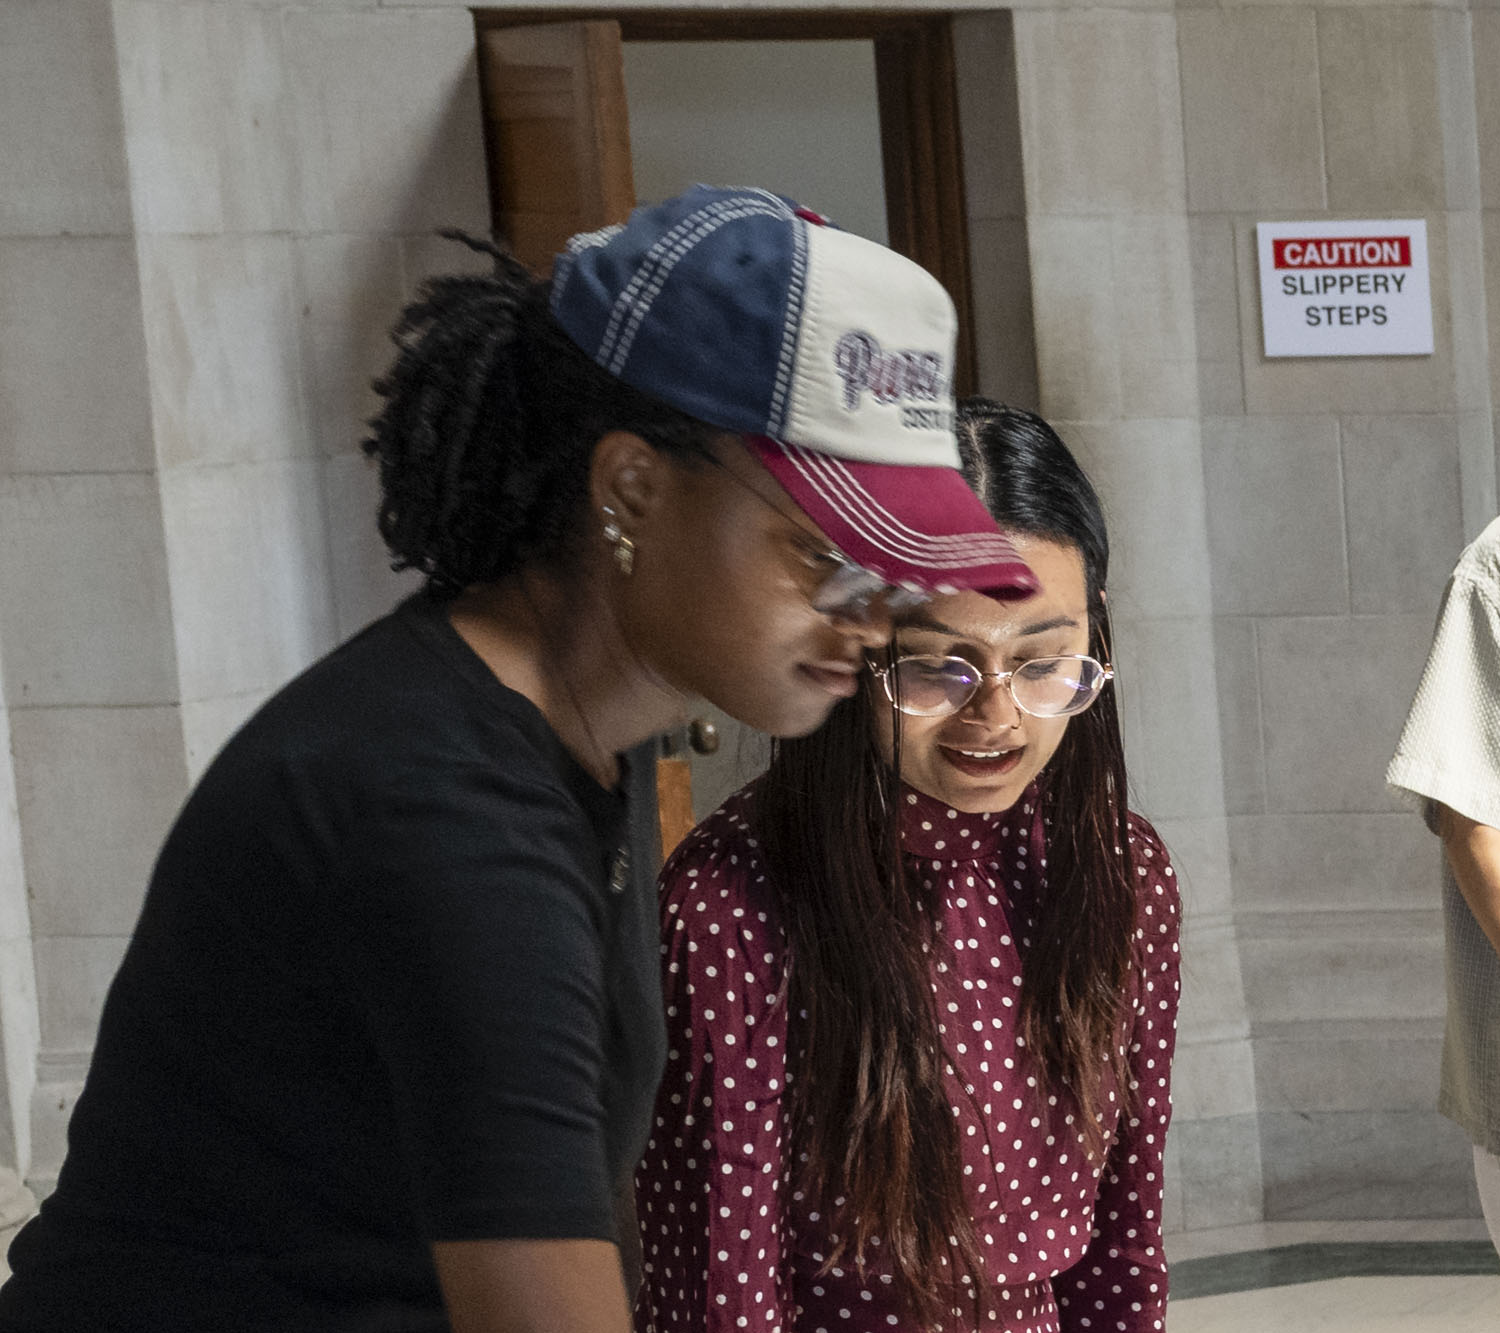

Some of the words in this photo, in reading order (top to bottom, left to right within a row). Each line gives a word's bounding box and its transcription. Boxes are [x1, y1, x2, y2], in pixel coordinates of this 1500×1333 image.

[1283, 241, 1401, 265] CAUTION
[1282, 274, 1406, 295] SLIPPERY
[1305, 305, 1388, 326] STEPS
